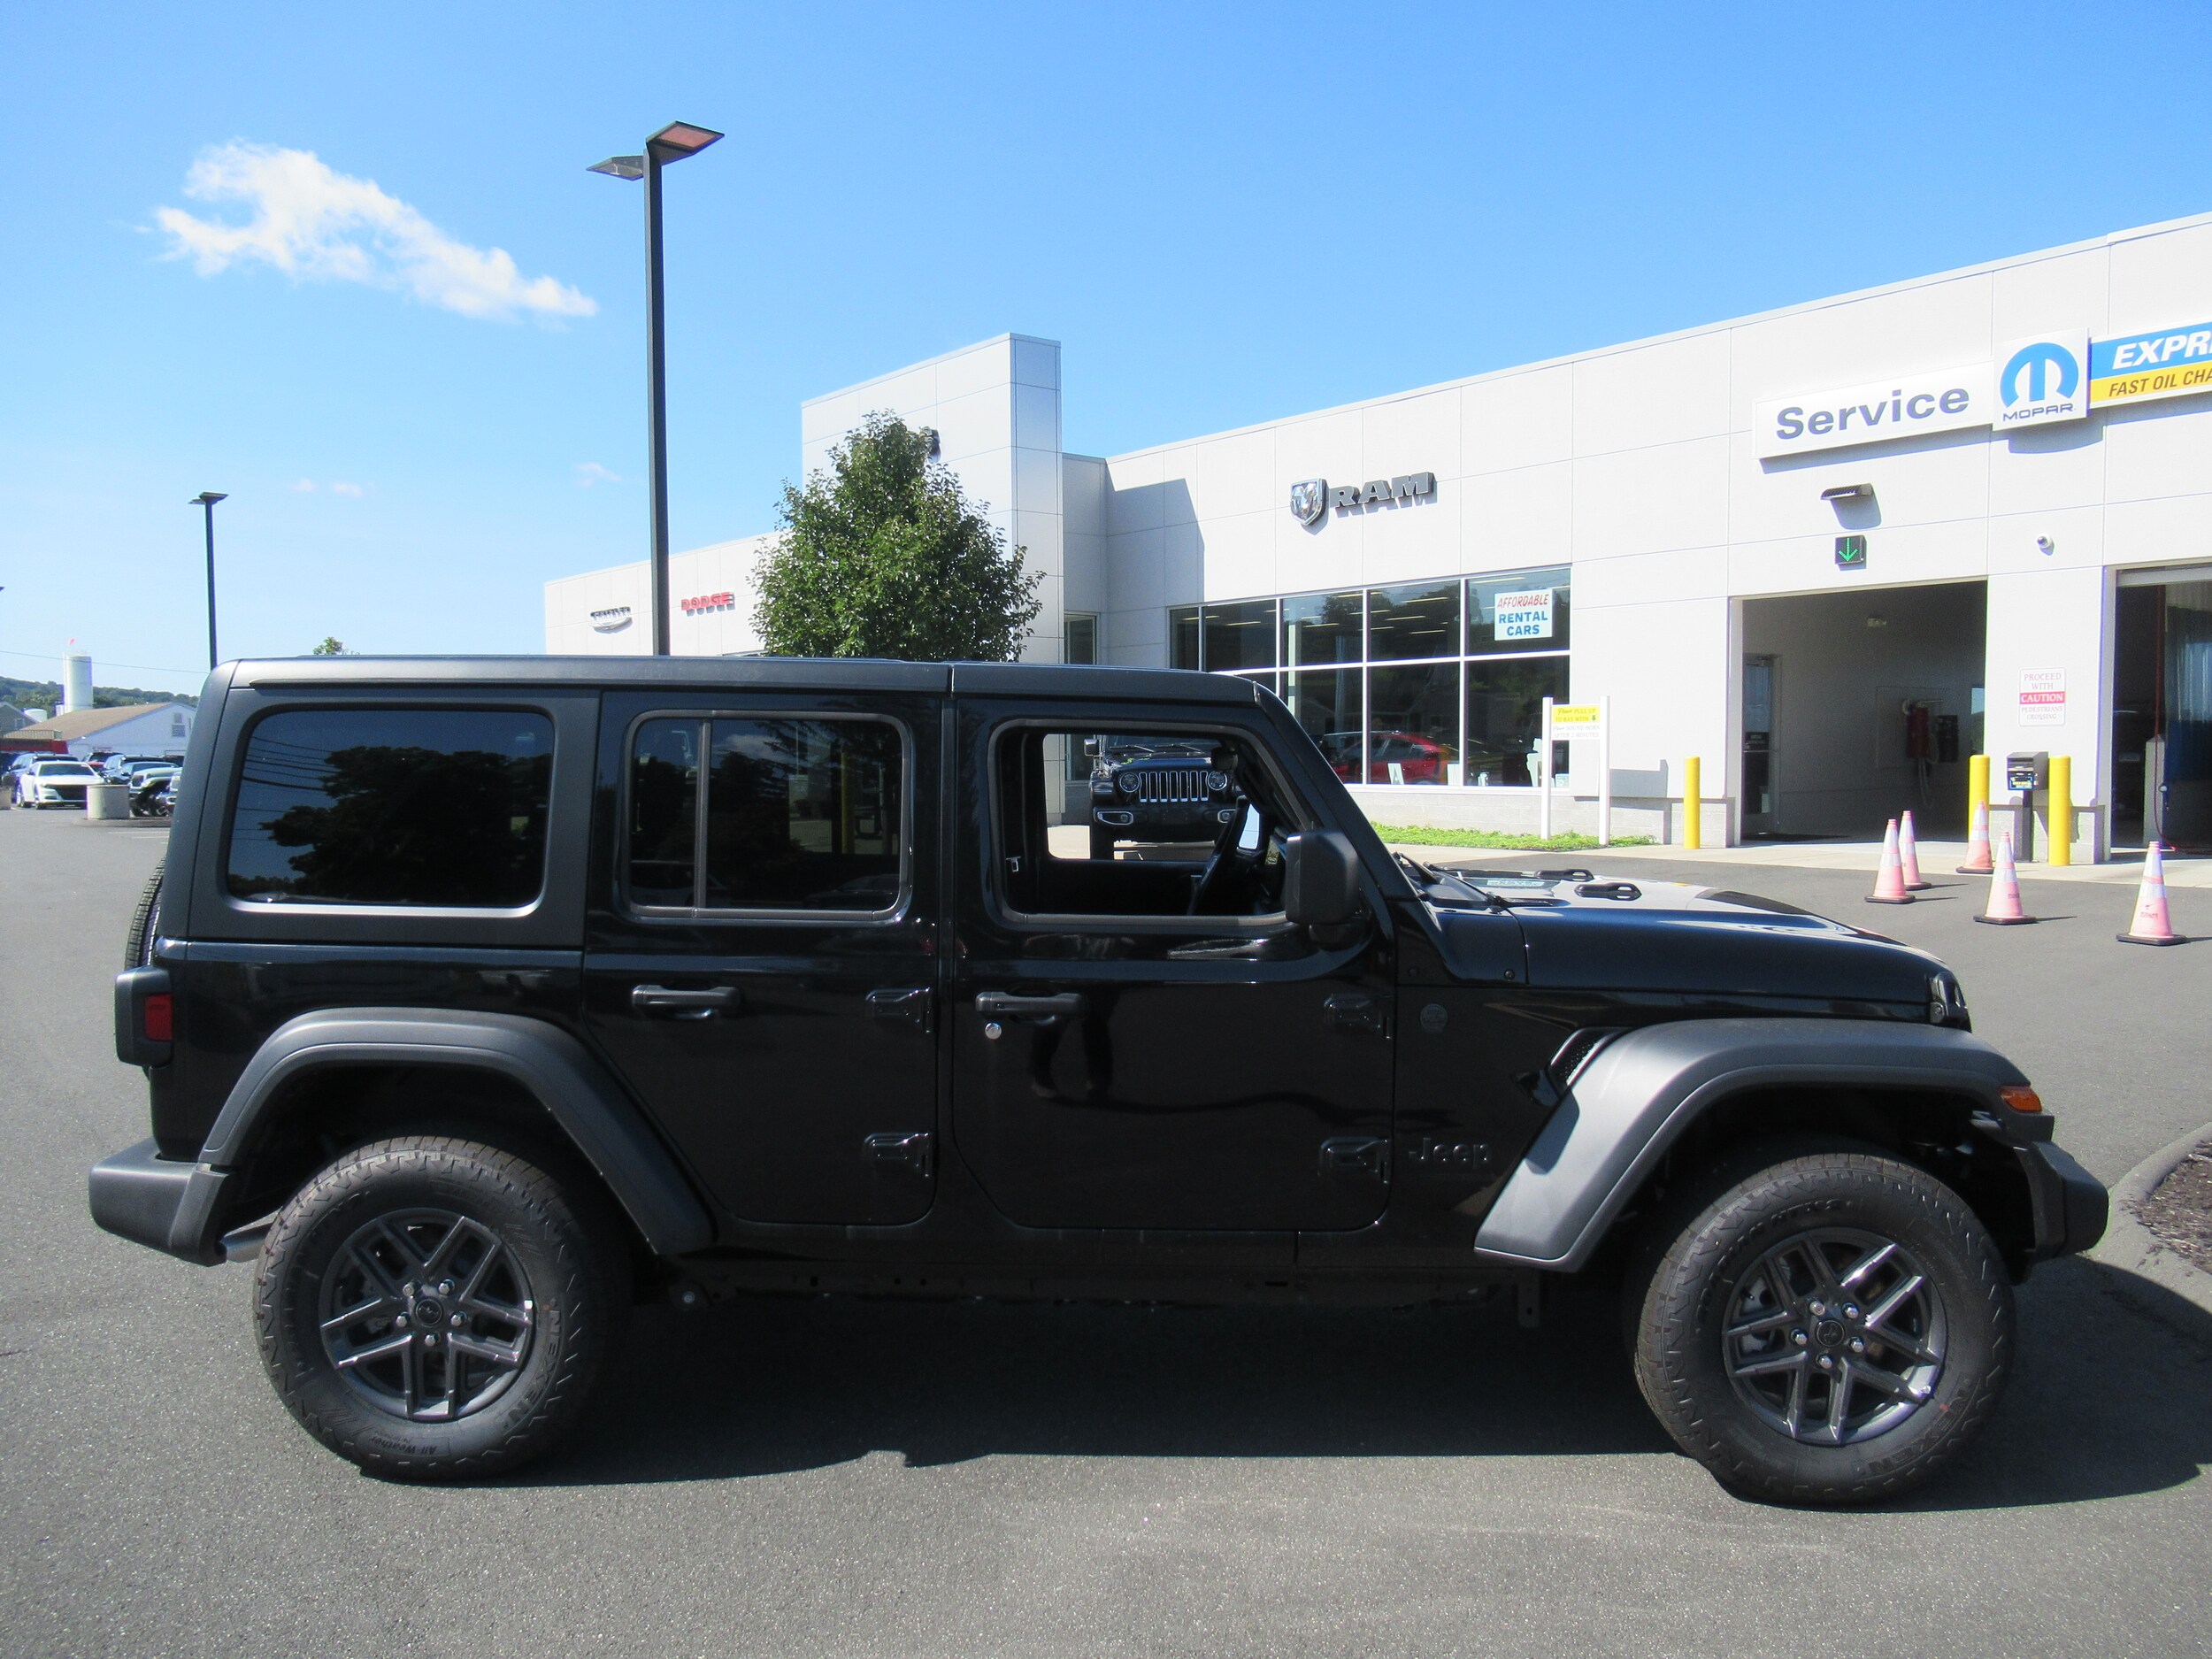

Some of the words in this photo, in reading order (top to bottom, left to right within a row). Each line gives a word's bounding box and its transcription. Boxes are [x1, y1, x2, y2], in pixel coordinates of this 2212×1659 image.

[2112, 330, 2212, 370] EXPR
[2109, 378, 2149, 396] FAST
[2153, 373, 2177, 390] OIL
[1776, 388, 1970, 440] Service
[2002, 403, 2074, 422] MOPAR
[1329, 472, 1432, 509] RAM
[680, 592, 734, 611] DODGE
[1497, 594, 1549, 609] AFFORDABLE
[1498, 611, 1548, 625] RENTAL
[1507, 625, 1540, 636] CARS
[2024, 672, 2062, 681] PROCEED
[2021, 693, 2063, 703] CAUTION
[1408, 1136, 1493, 1170] Jeep
[508, 1310, 561, 1423] NEXEN
